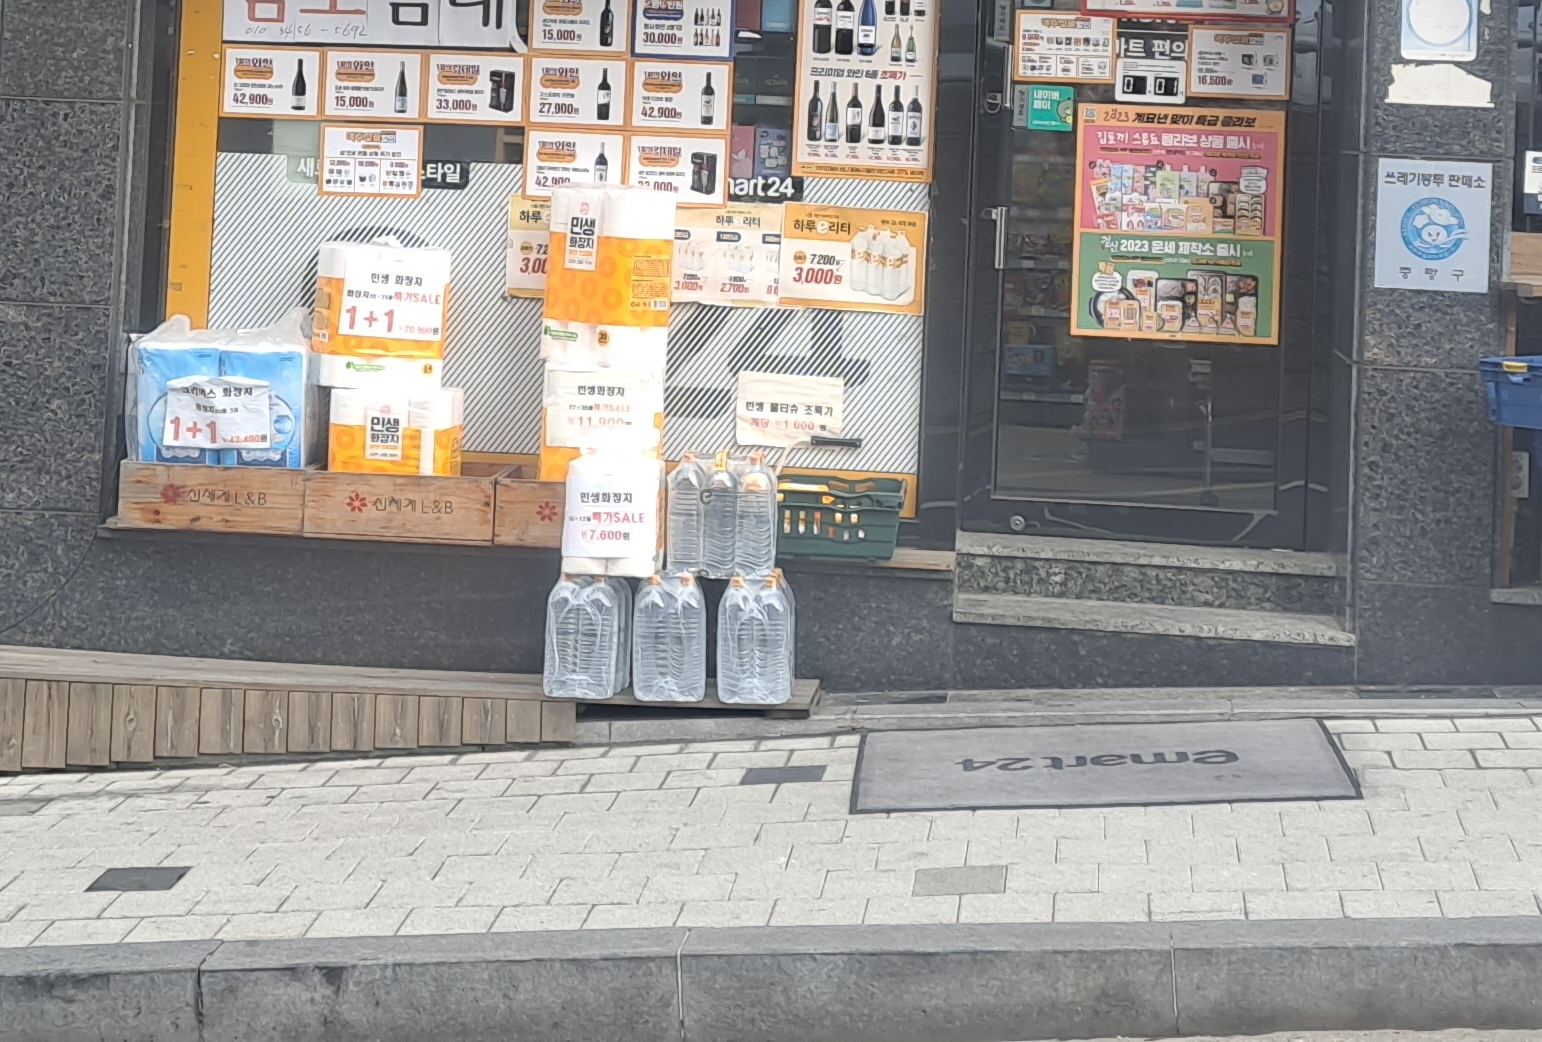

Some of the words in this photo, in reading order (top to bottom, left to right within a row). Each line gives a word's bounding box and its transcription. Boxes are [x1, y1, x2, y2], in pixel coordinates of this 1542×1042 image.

[1033, 89, 1060, 100] 네이버
[1033, 100, 1051, 110] 페이
[1103, 110, 1130, 123] 2023
[1132, 112, 1169, 125] 계묘년
[1170, 113, 1194, 126] 맞이
[1195, 115, 1220, 127] 특급
[1221, 115, 1257, 128] 콜라보
[1161, 133, 1199, 147] 콜라보
[1199, 134, 1225, 149] 상품
[1226, 134, 1252, 150] 출시
[1385, 171, 1445, 188] 쓰레기봉투
[1448, 172, 1486, 189] 판매소
[570, 216, 597, 236] 민생
[569, 236, 594, 250] 화장지
[1120, 239, 1150, 253] 2023
[1151, 240, 1177, 255] 운세
[1177, 241, 1215, 256] 제작소
[1216, 243, 1242, 258] 출시
[370, 273, 390, 285] 민생
[394, 275, 423, 288] 화장지
[793, 267, 843, 286] 3,000원
[345, 305, 396, 333] 1+1
[222, 386, 253, 398] 화장지
[577, 385, 626, 398] 민생화장지
[170, 416, 218, 444] 1+1
[370, 416, 400, 433] 민생
[370, 433, 399, 444] 화장지
[187, 488, 230, 504] 신세계
[235, 491, 267, 507] L&B
[372, 497, 416, 512] 신세계
[421, 499, 454, 515] L&B
[580, 491, 633, 504] 민생화장지
